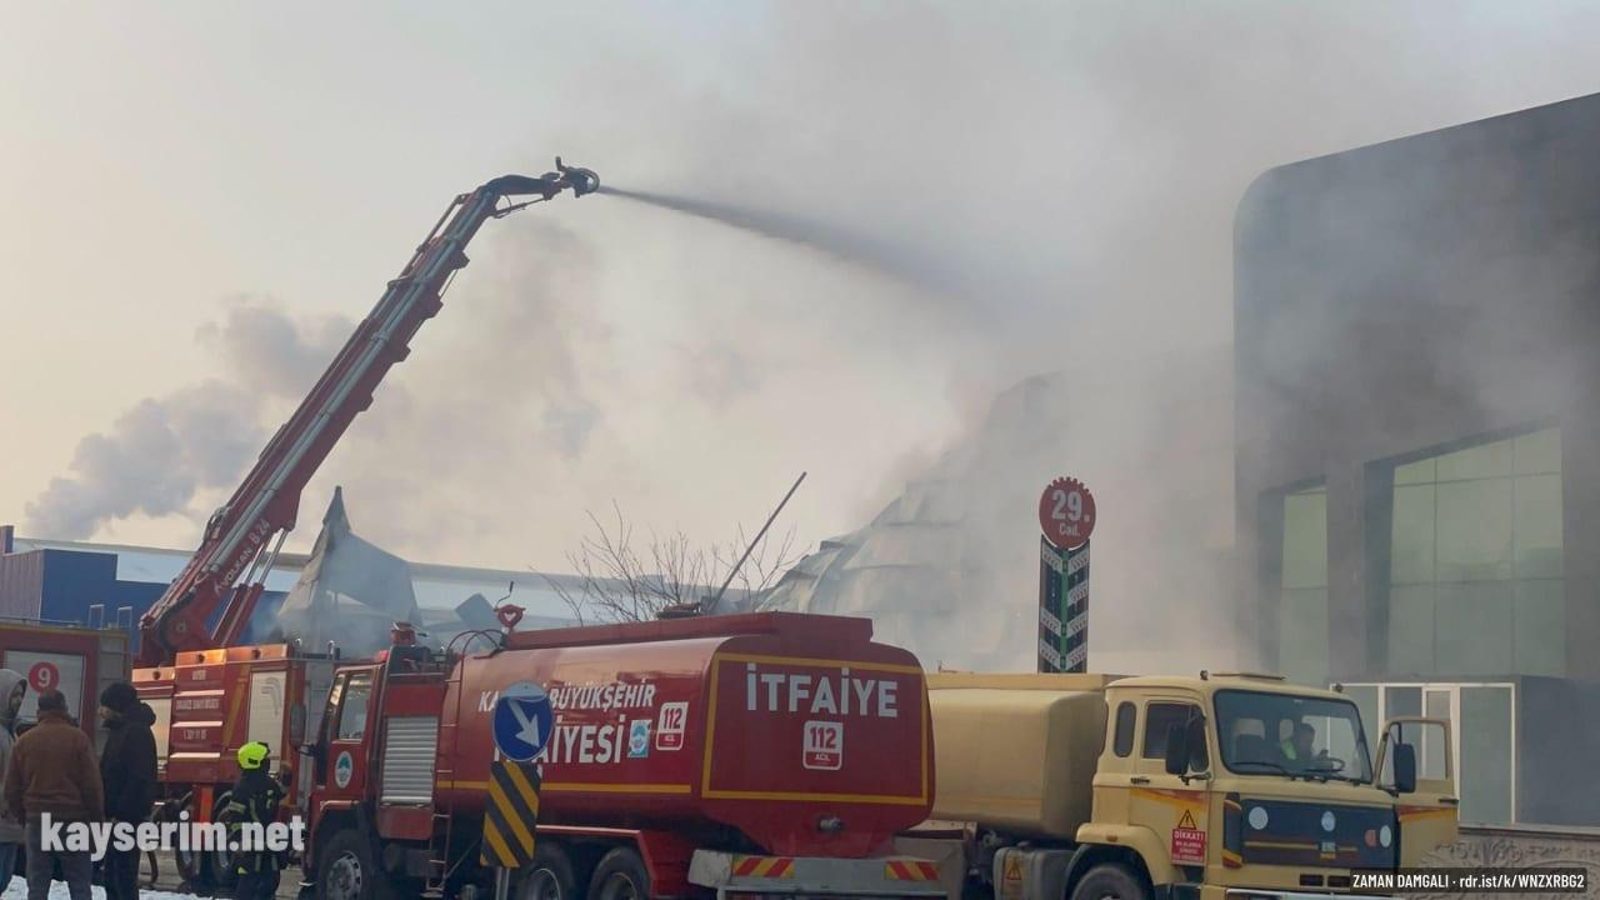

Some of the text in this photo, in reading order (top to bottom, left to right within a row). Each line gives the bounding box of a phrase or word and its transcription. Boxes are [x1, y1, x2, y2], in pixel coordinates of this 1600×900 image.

[1052, 489, 1090, 523] 29.
[38, 667, 51, 688] 9
[747, 663, 898, 718] İTFAİYE
[551, 678, 656, 713] BÜYÜKŞEHİR
[664, 707, 683, 729] 112
[809, 727, 837, 749] 112
